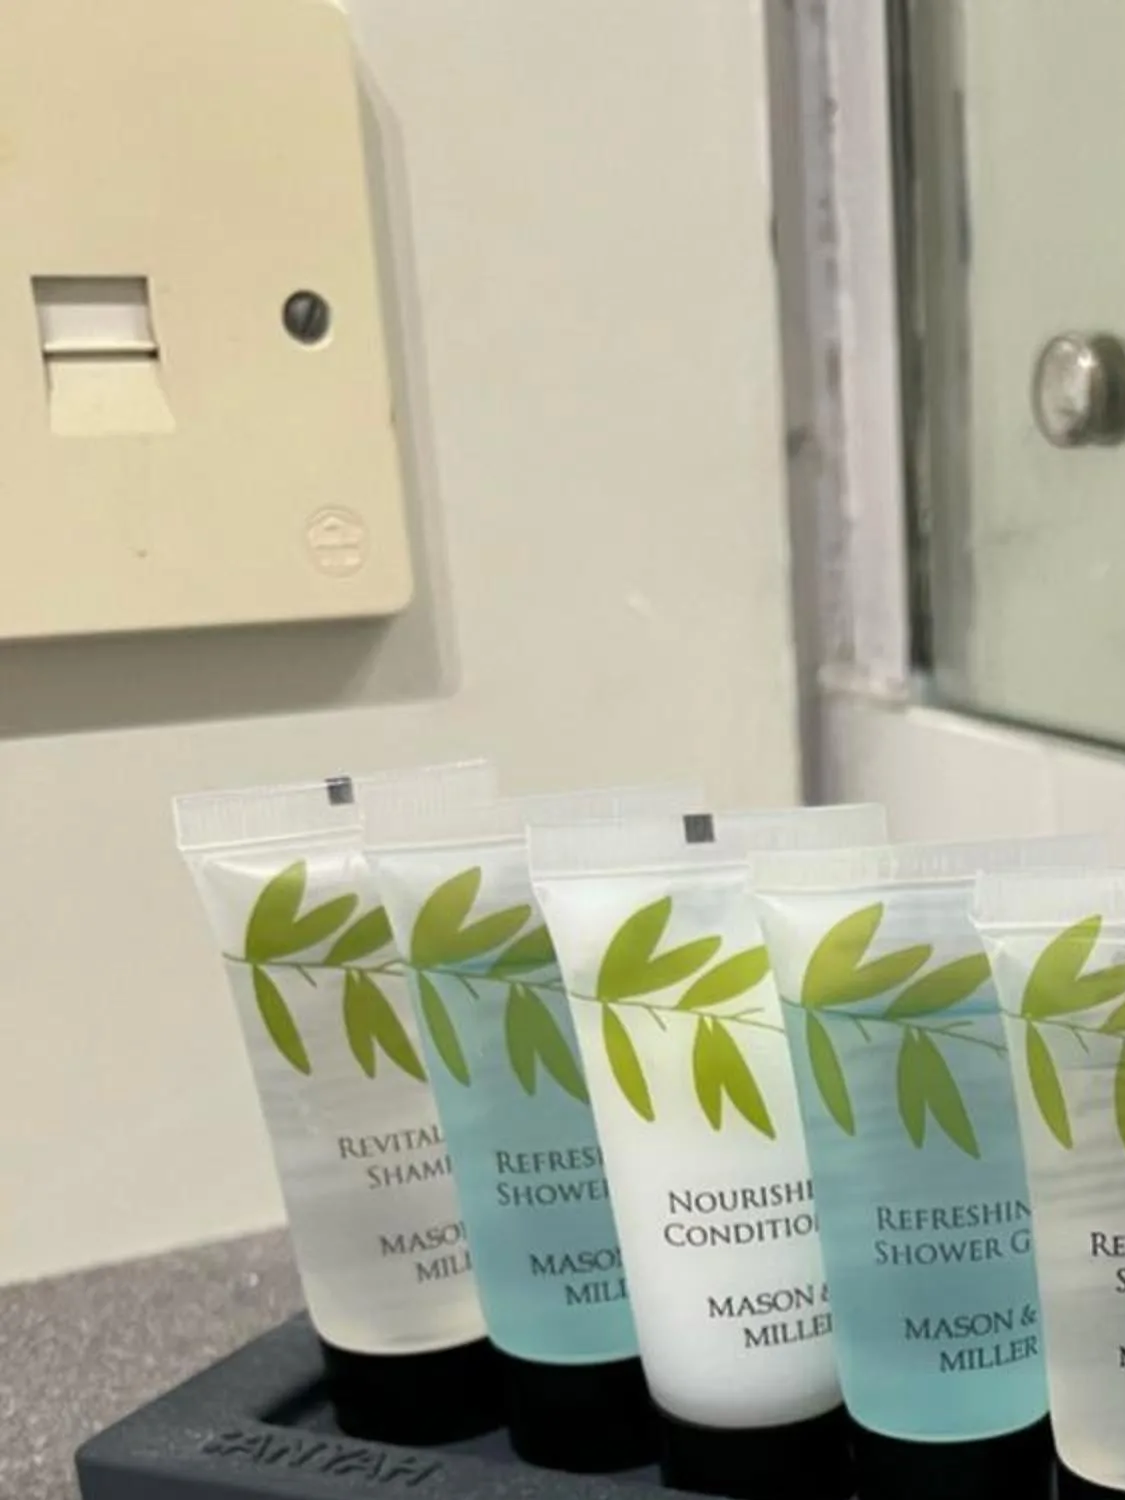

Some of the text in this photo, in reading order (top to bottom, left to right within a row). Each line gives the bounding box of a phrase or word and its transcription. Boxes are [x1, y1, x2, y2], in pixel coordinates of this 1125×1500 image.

[496, 1146, 604, 1174] REFRES
[663, 1212, 821, 1247] CONDITIO
[874, 1237, 1004, 1266] SHOWER
[706, 1284, 815, 1319] MASON
[904, 1302, 1038, 1341] MASON &
[939, 1335, 1039, 1373] MILLER
